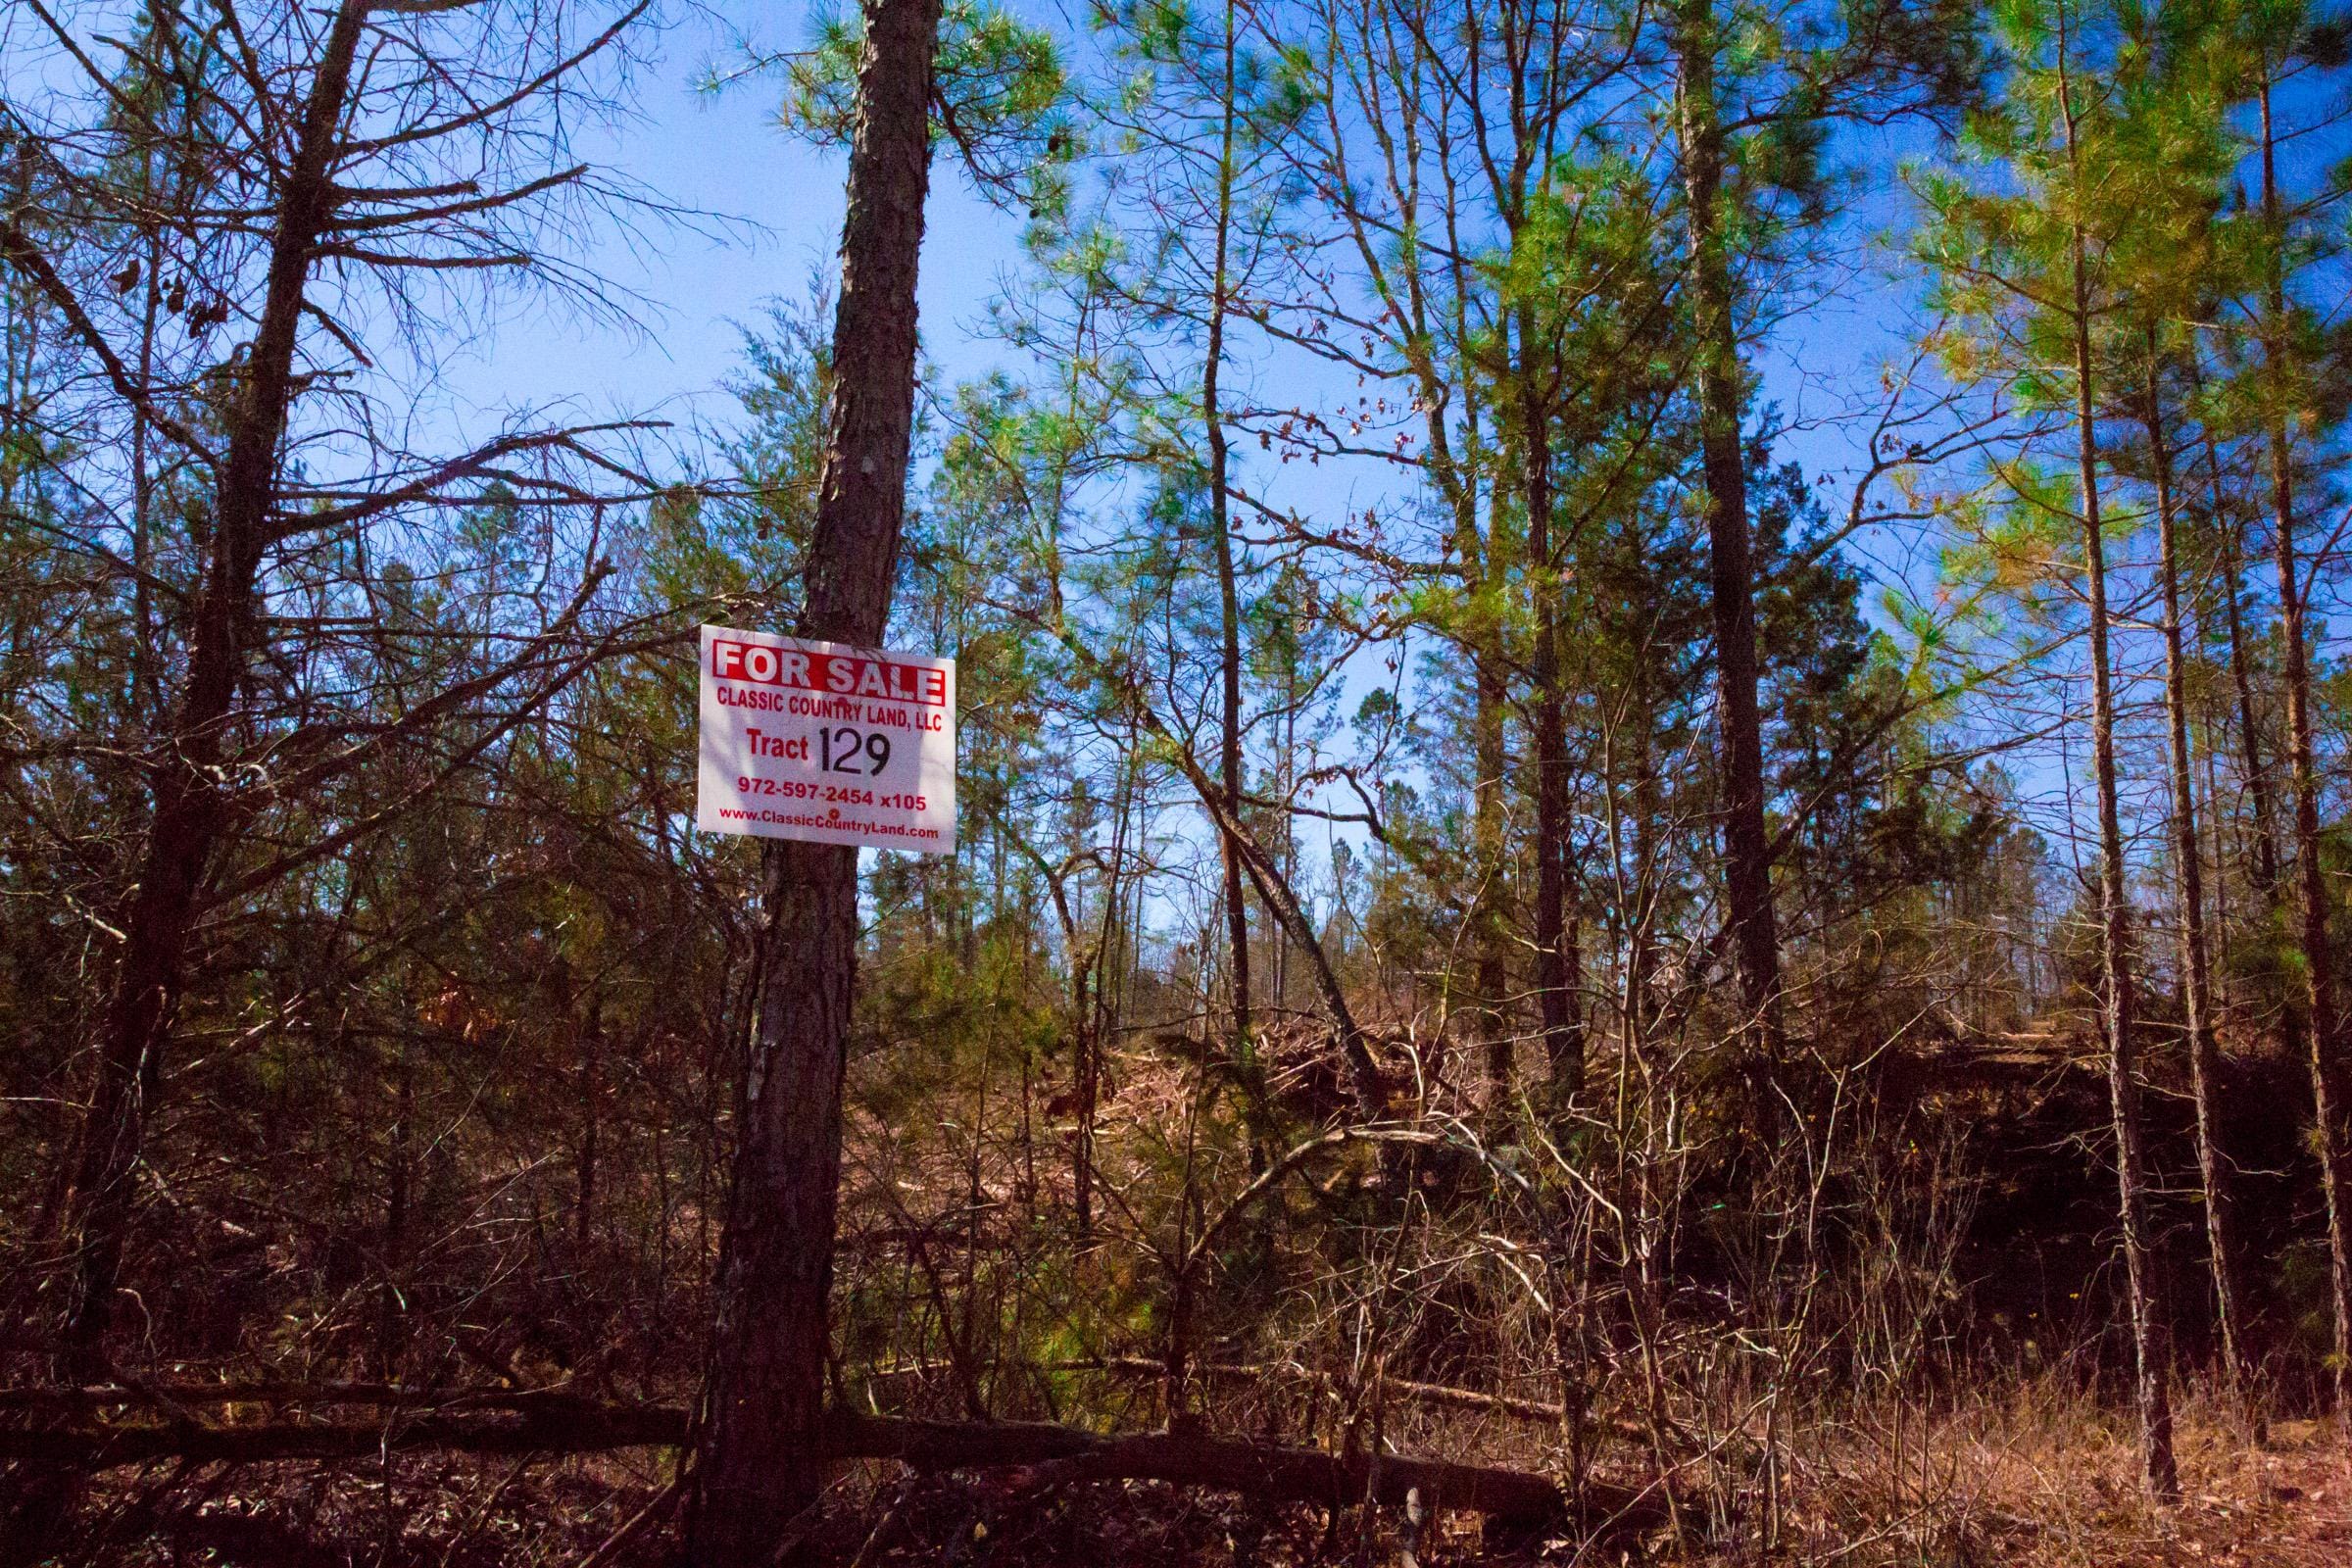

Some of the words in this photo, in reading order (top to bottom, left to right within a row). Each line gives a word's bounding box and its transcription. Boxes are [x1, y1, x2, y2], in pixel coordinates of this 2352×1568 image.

[715, 642, 810, 688] FOR
[827, 658, 944, 704] SALE
[717, 686, 784, 712] CLASSIC
[789, 696, 863, 721] COUNTRY
[867, 705, 911, 732] LAND,
[915, 713, 942, 732] LLC
[746, 728, 808, 760] Tract
[819, 726, 891, 777] 129
[738, 776, 873, 806] 972-597-2454
[880, 795, 927, 811] x105
[719, 807, 939, 839] www.ClassicCountryLand.com
